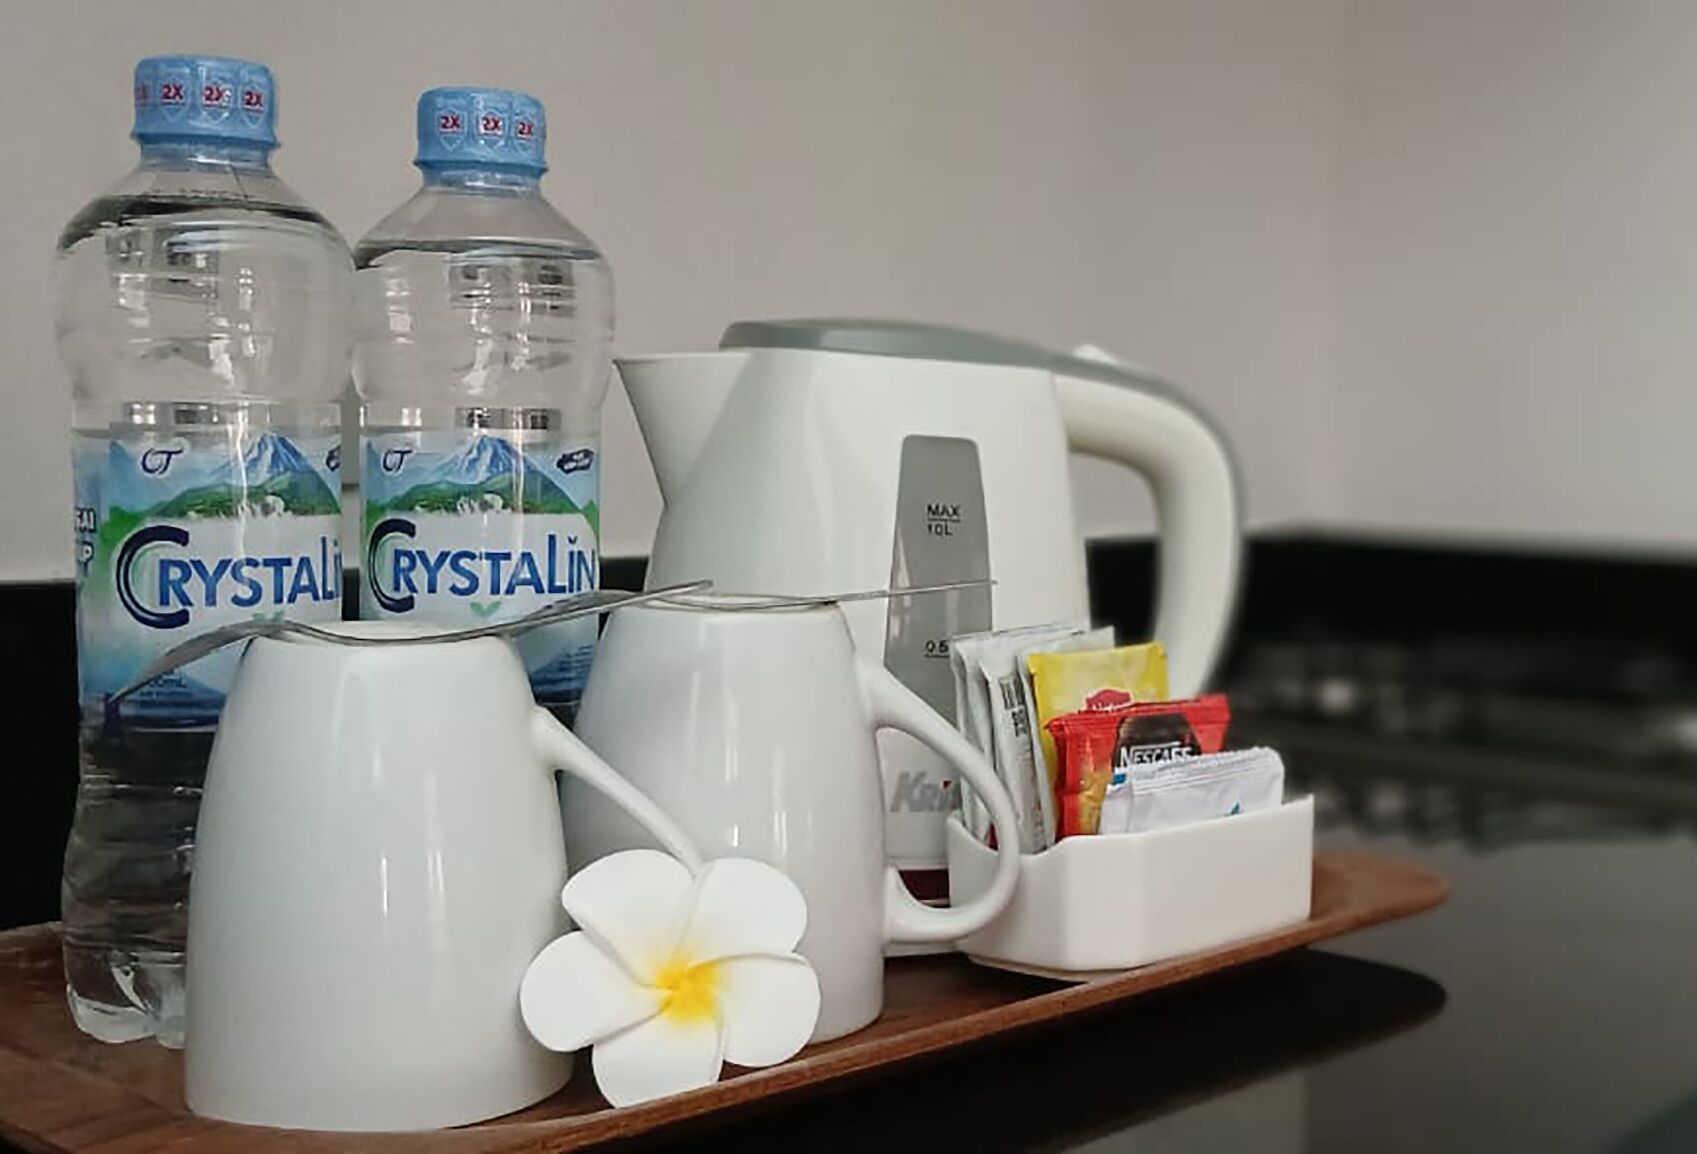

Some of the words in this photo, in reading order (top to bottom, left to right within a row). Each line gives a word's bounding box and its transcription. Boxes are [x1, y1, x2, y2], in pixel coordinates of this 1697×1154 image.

[162, 84, 183, 100] 2X
[245, 91, 264, 107] 2X
[441, 115, 460, 130] 2X
[482, 116, 501, 132] 2X
[927, 503, 961, 518] MAX
